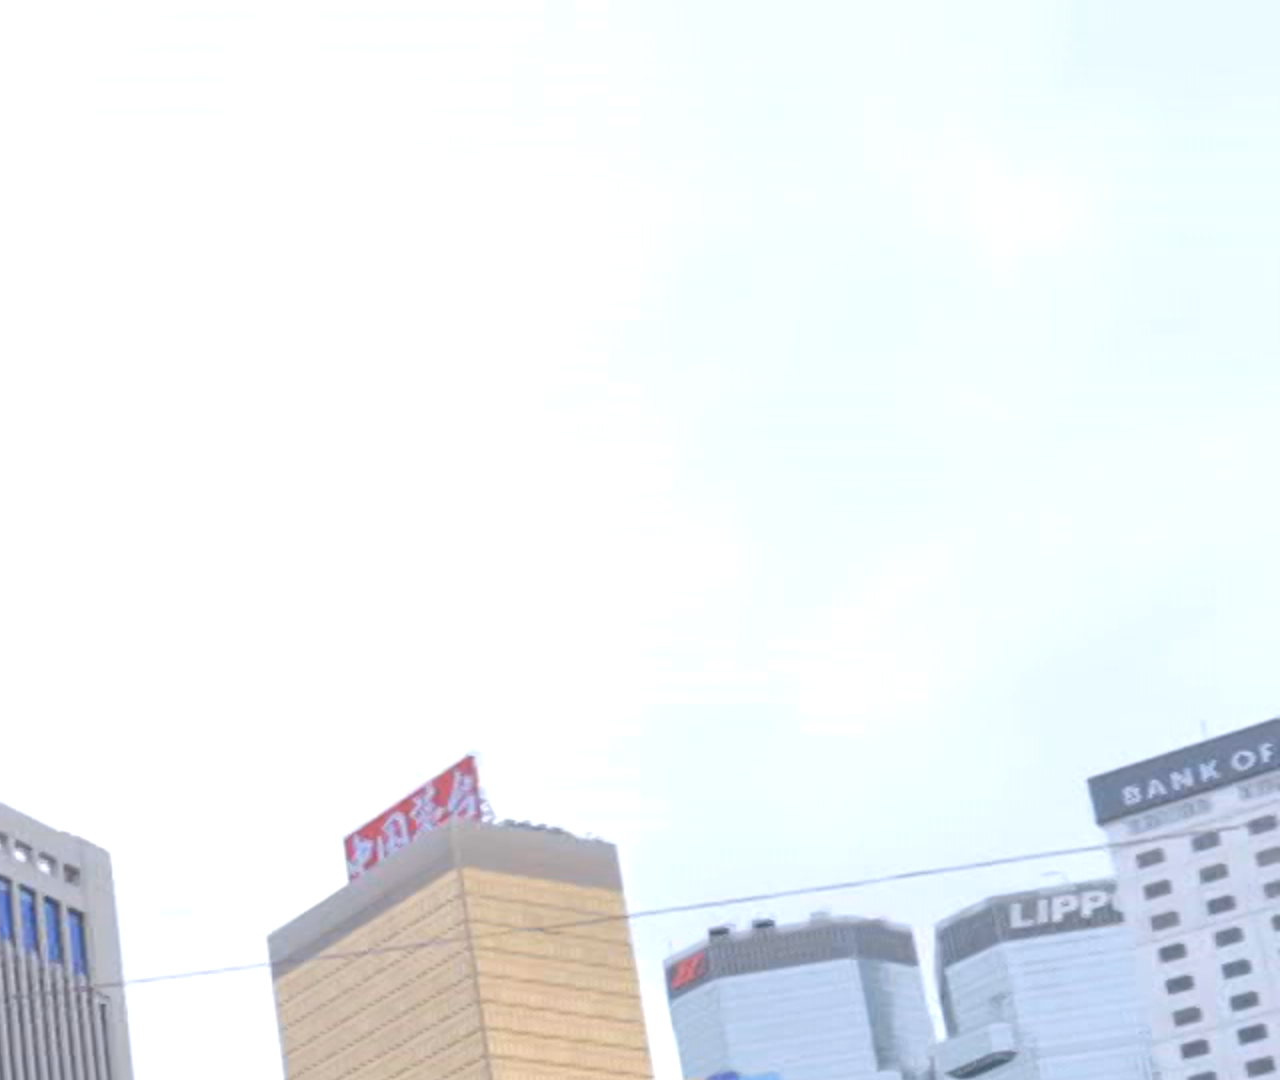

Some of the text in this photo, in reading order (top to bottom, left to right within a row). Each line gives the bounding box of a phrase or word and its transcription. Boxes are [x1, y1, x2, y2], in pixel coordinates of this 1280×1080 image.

[1121, 743, 1274, 806] BANK OF
[1008, 889, 1116, 929] LIPP
